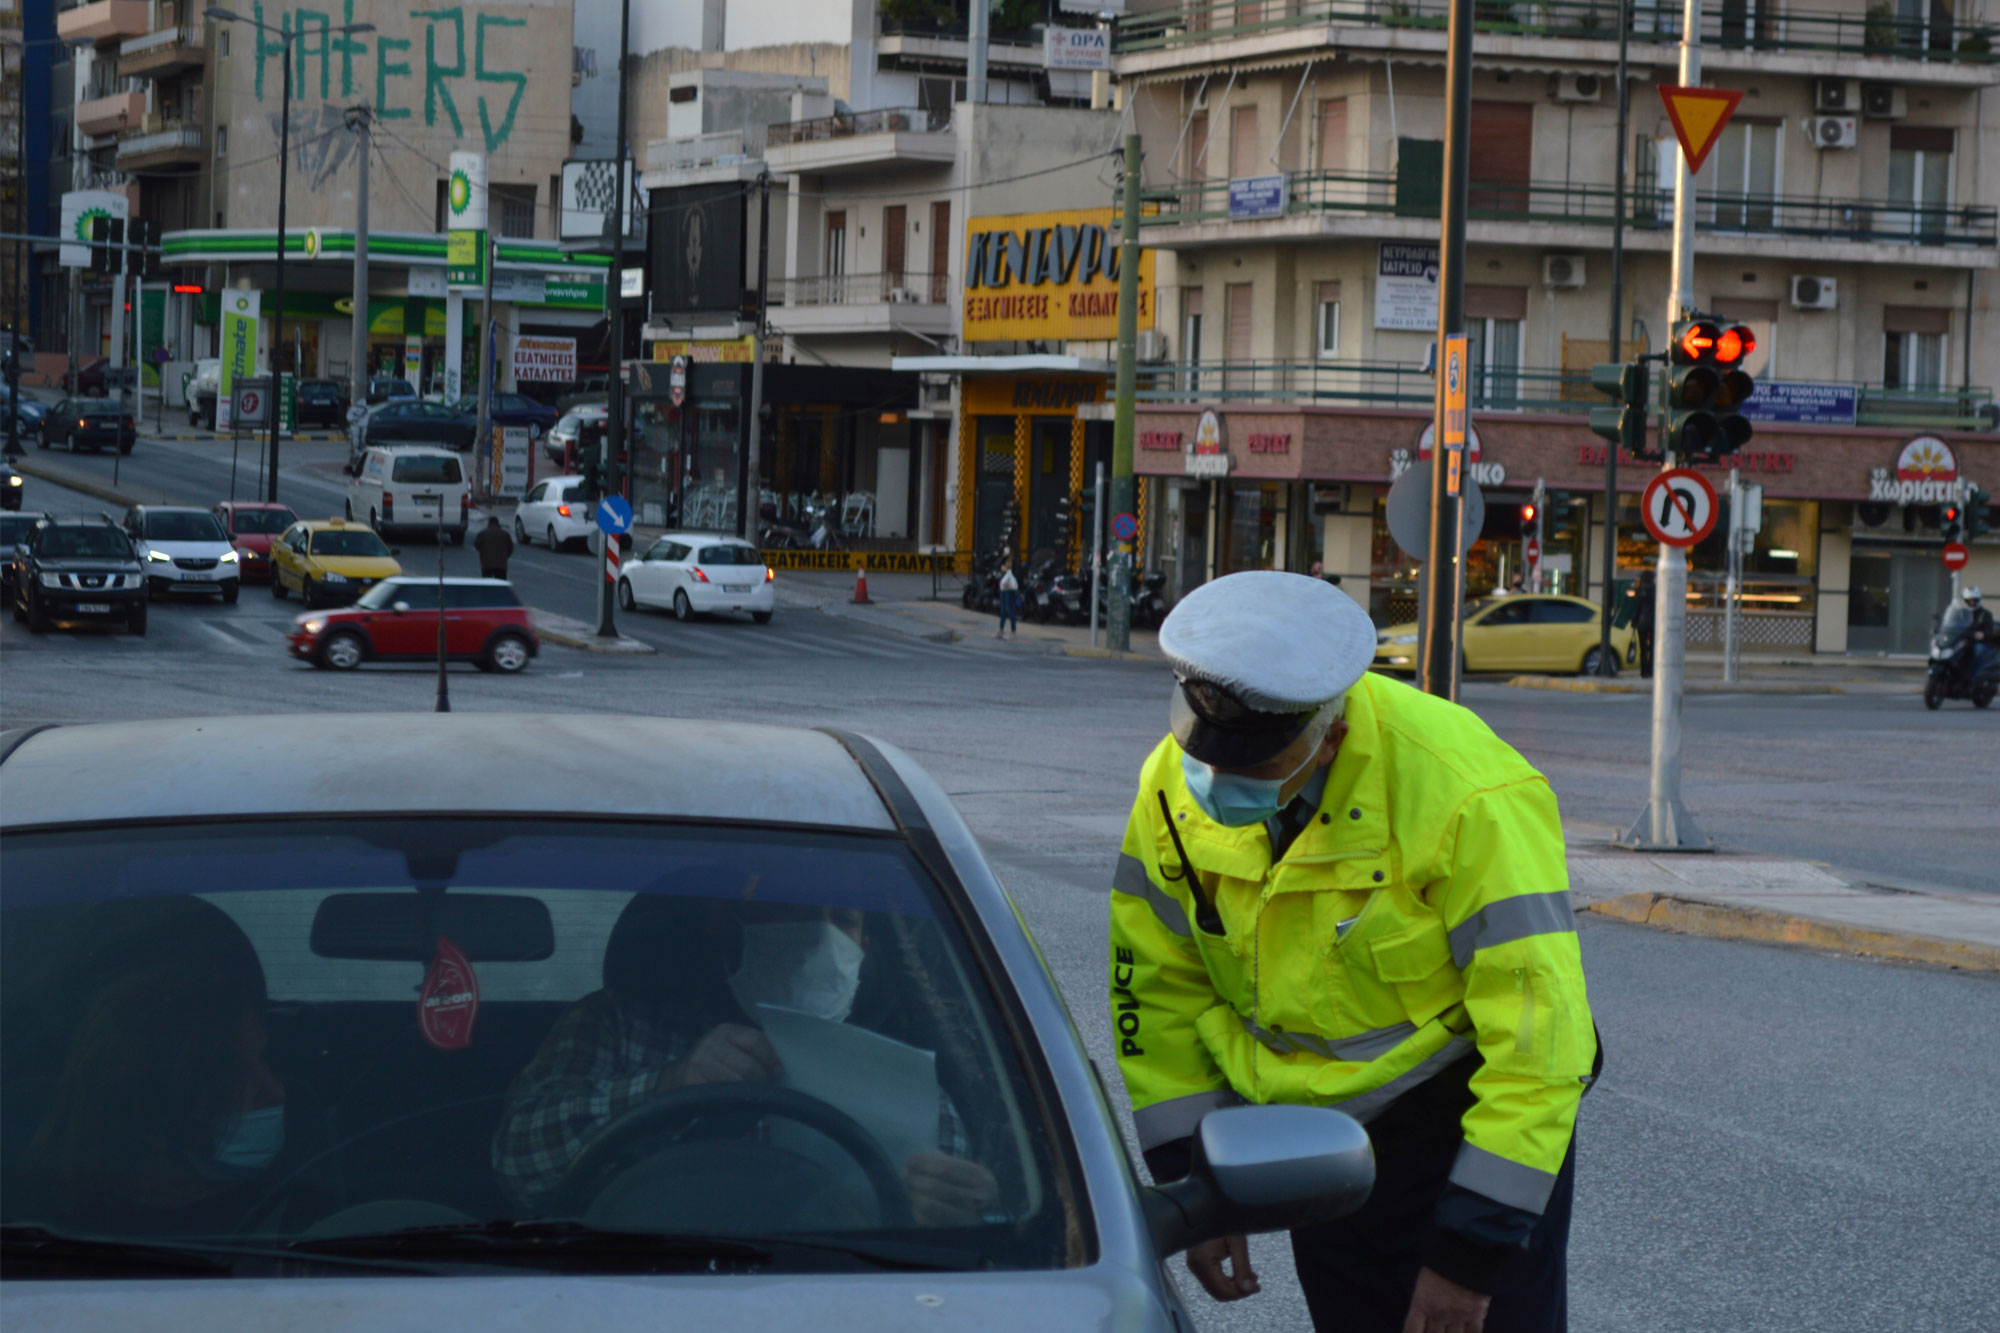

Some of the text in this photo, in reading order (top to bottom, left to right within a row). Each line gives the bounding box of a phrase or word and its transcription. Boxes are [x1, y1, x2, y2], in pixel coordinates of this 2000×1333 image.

[1383, 261, 1422, 273] ΙΑΤΡΕΙΟ
[966, 293, 1049, 321] ΕΞΑΤΜΙΣΕΙΣ
[514, 351, 574, 365] ΕΞΑΤΜΙΣΕΙΣ
[514, 366, 574, 380] ΚΑΤΑΛΥΤΕΣ
[1140, 432, 1182, 450] BAKERY
[1248, 433, 1291, 453] PASTRY
[760, 551, 955, 571] ΕΞΑΤΜΙΣΕΙΣ ΚΑΤΑΛΥΤΕΣ
[1113, 945, 1145, 1057] POLICE
